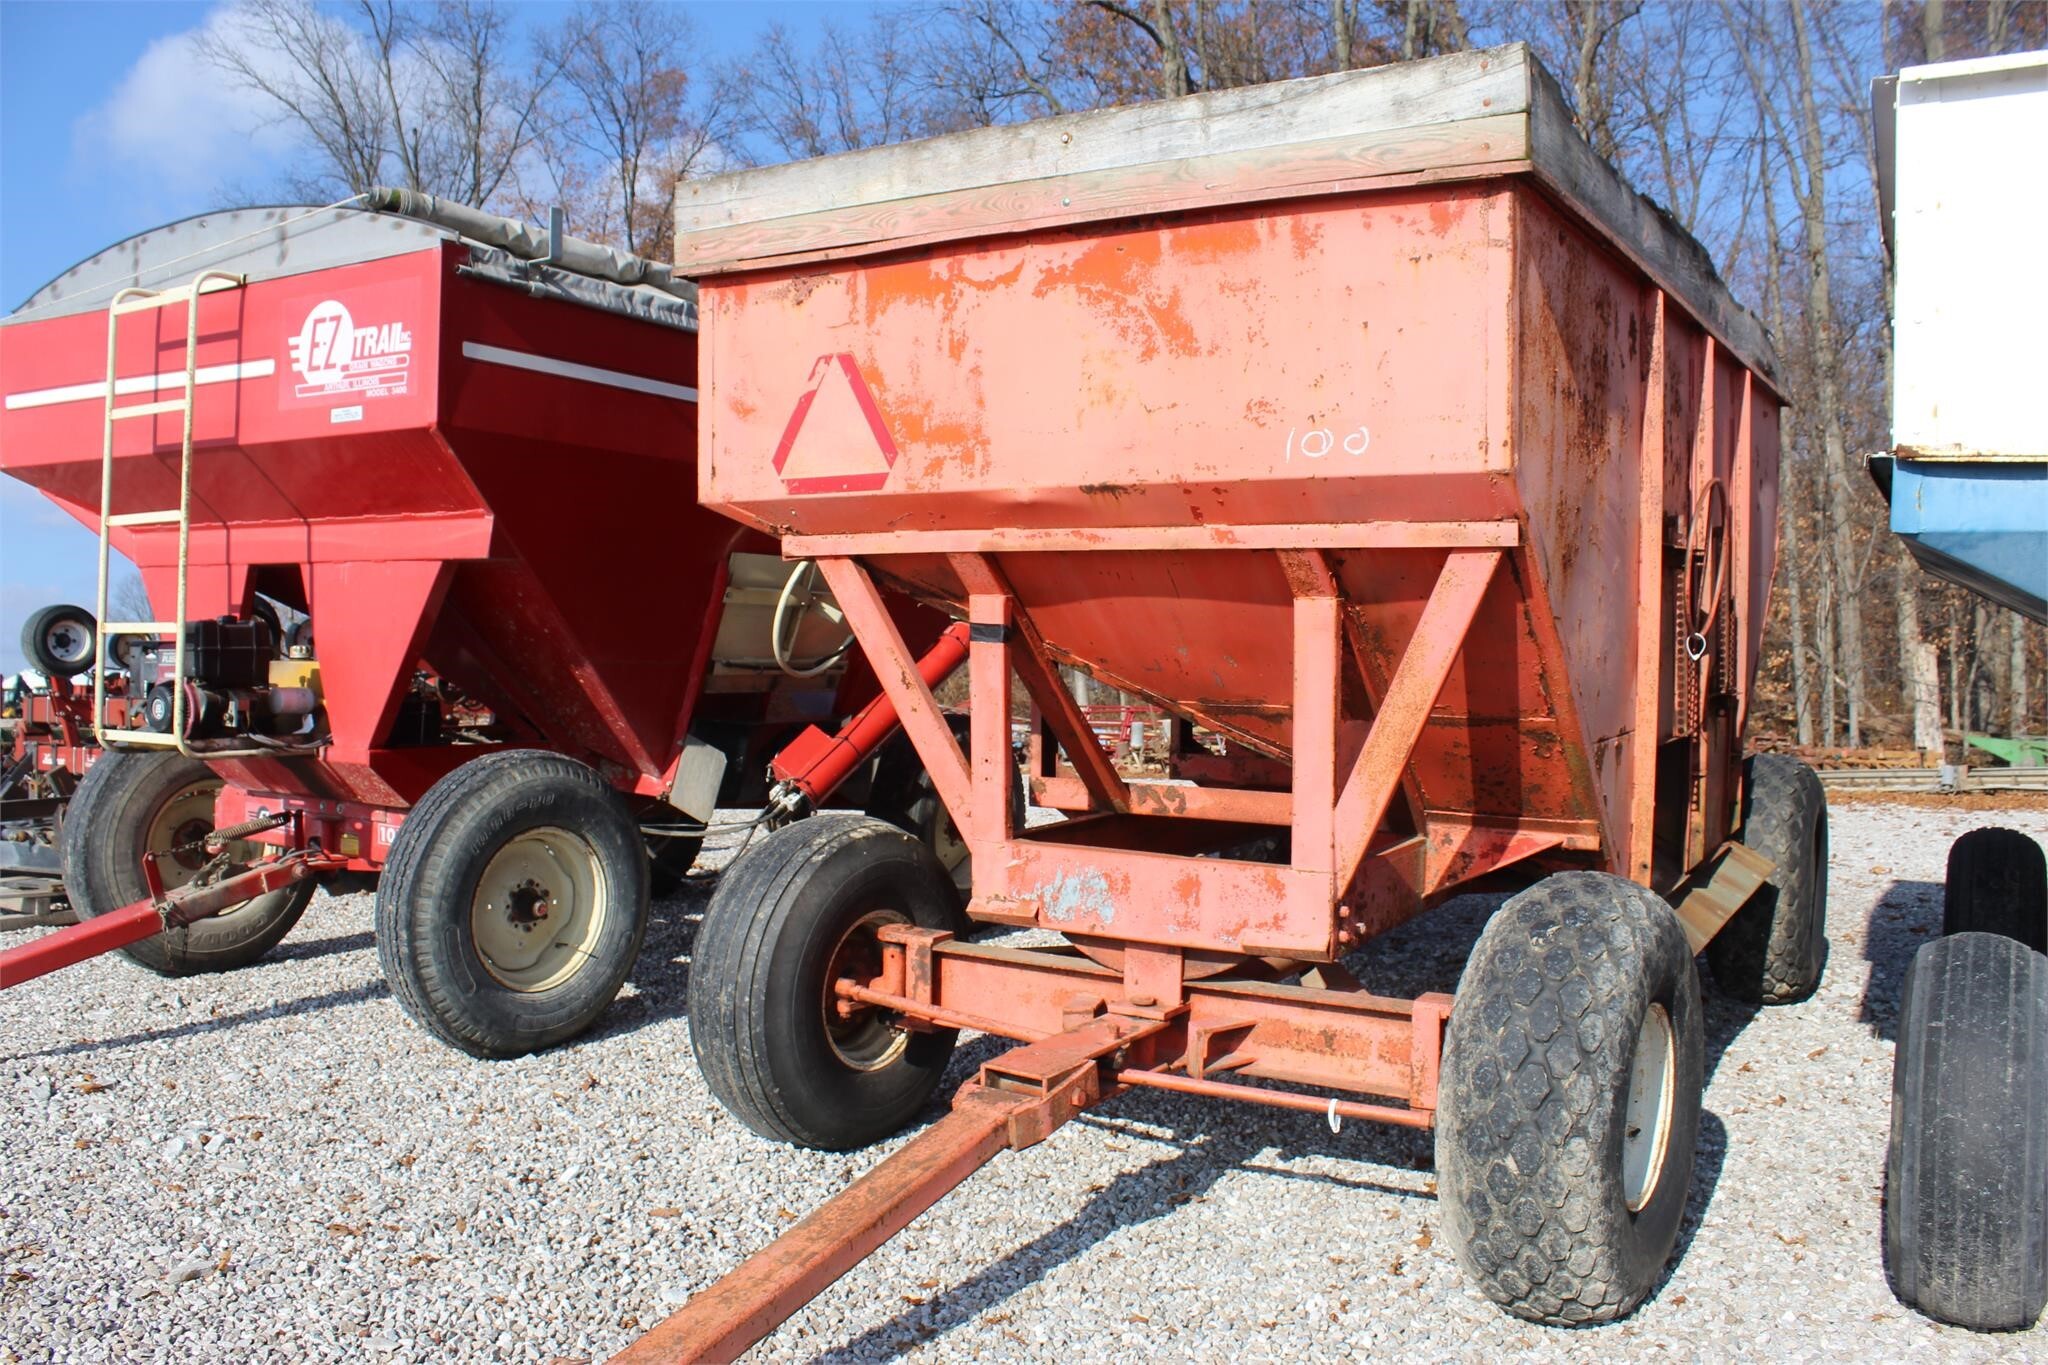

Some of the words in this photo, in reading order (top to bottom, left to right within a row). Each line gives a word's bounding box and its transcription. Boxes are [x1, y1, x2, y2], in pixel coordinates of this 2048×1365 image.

[353, 322, 411, 358] TRAIL
[365, 388, 389, 398] MODEL
[1285, 426, 1369, 463] 100
[380, 826, 399, 843] 10
